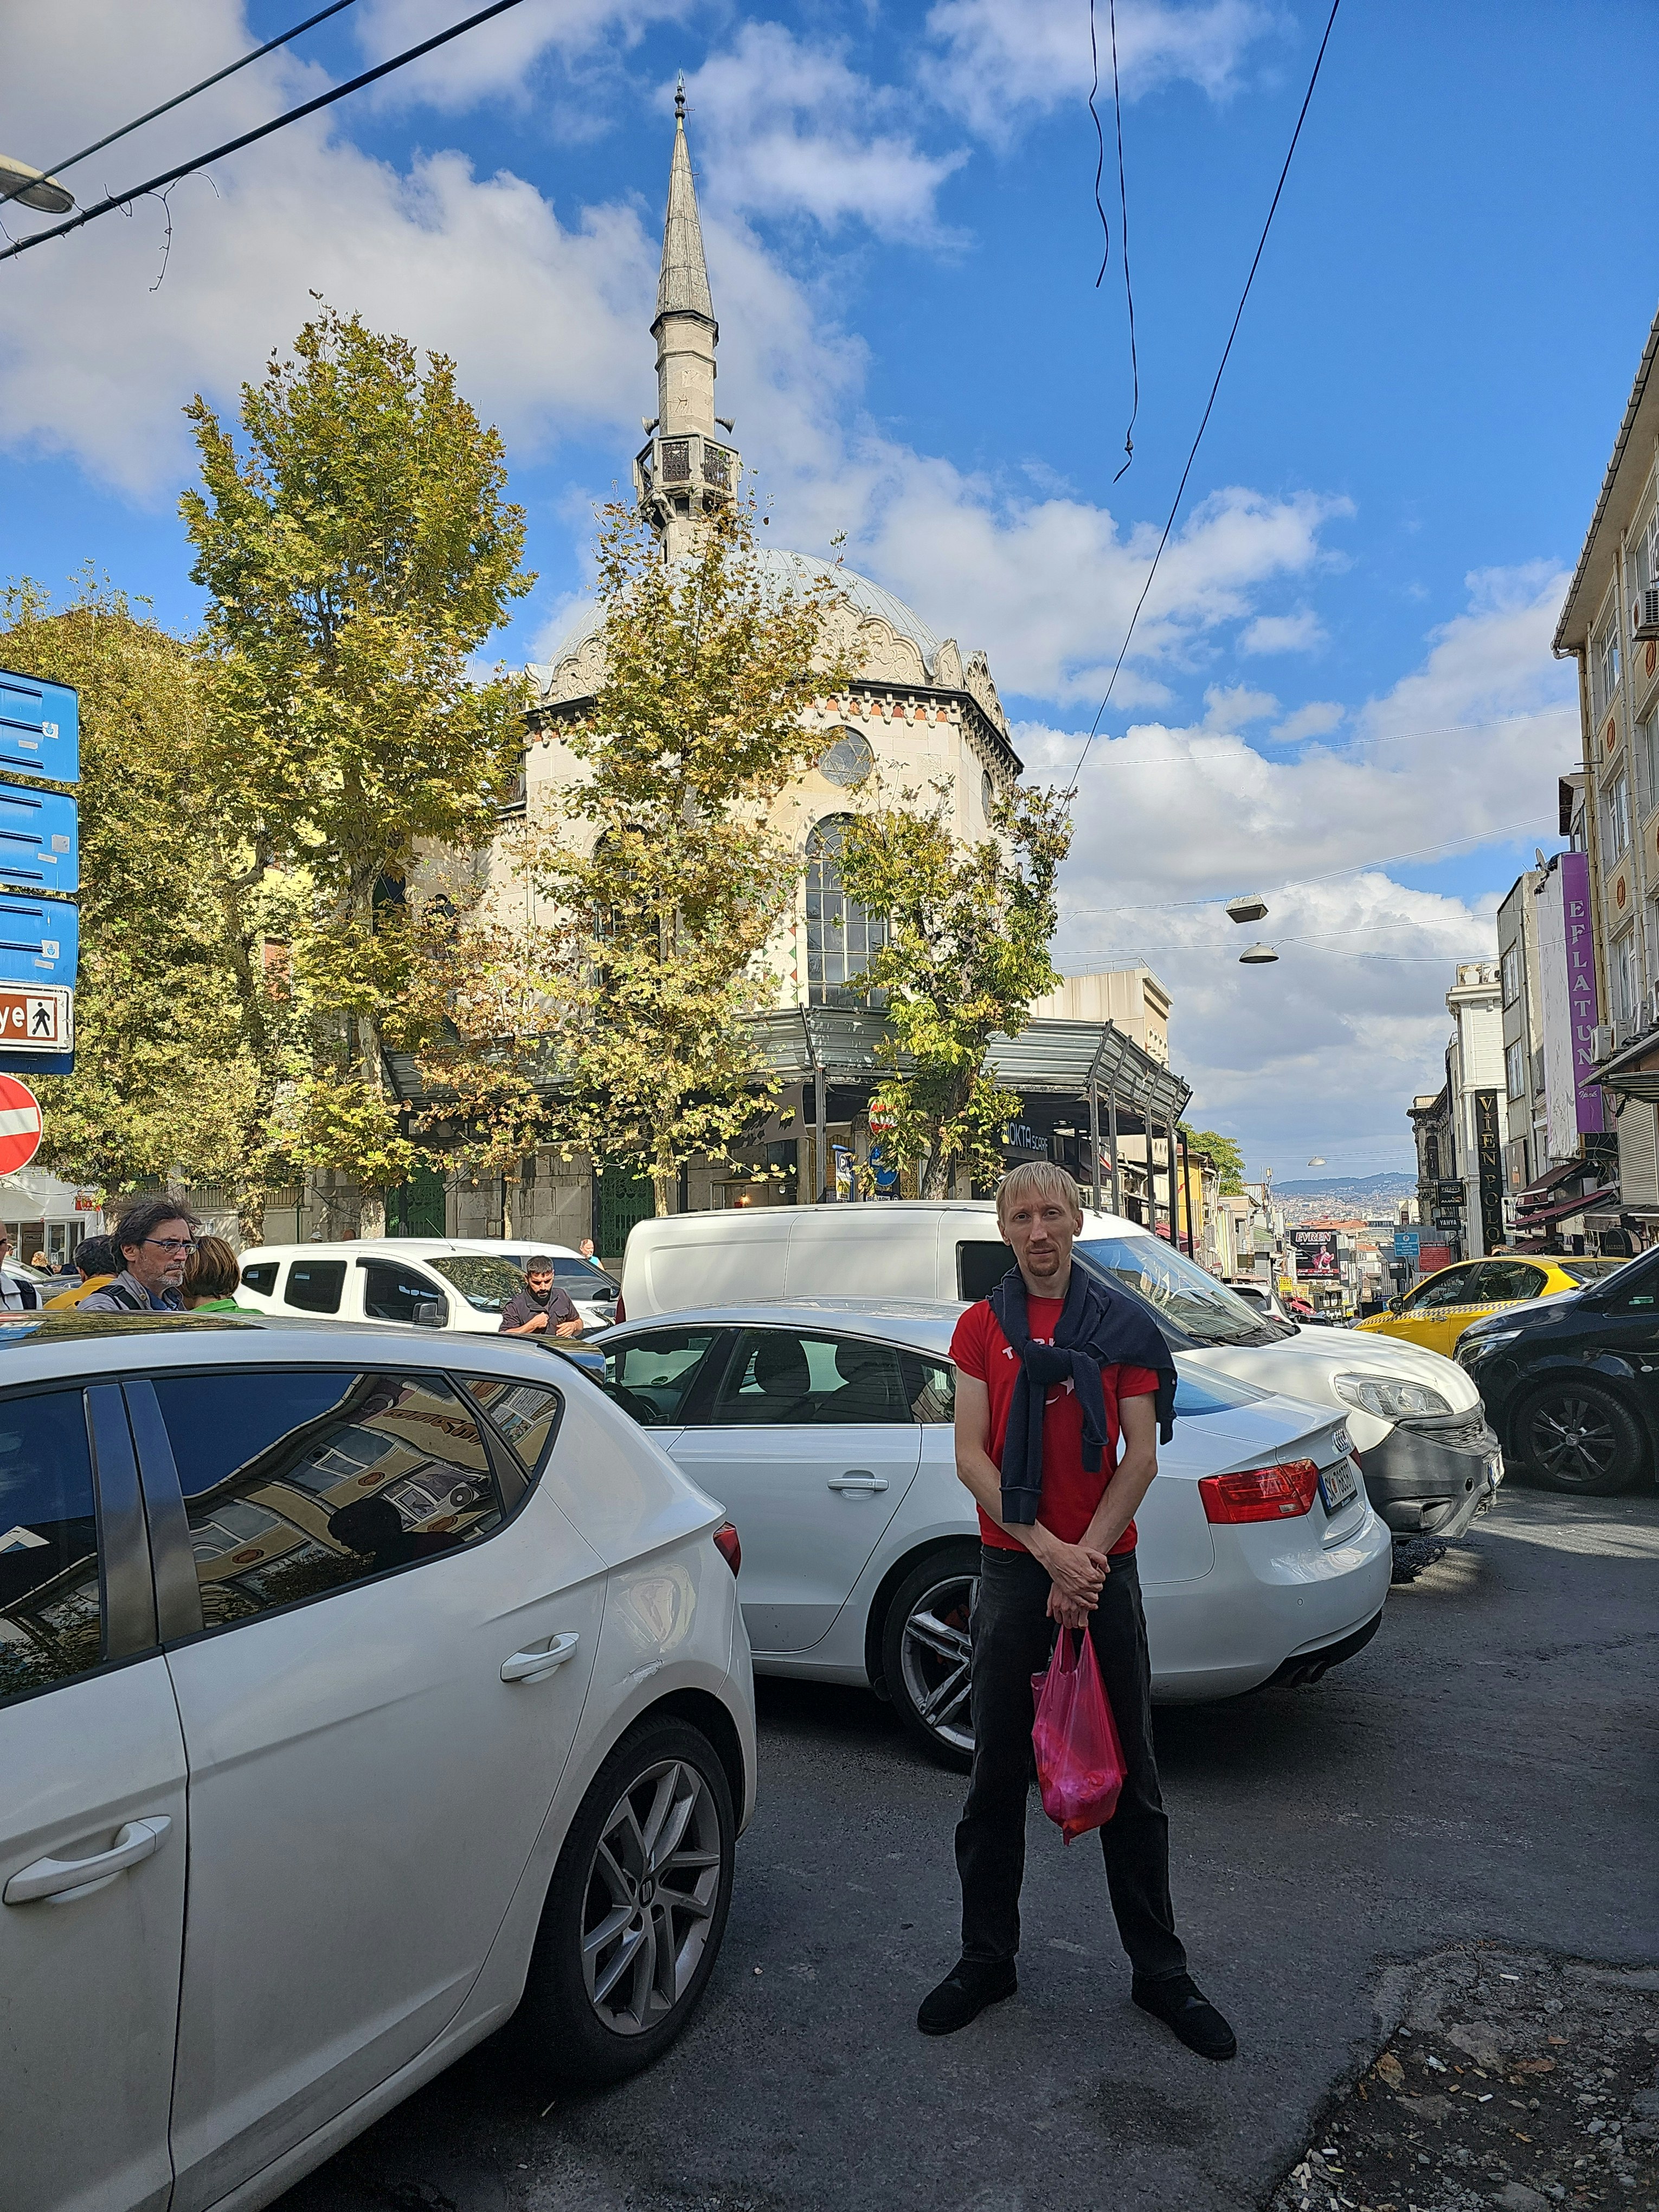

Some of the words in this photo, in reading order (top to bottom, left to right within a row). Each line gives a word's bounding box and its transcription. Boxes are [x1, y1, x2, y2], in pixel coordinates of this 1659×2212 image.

[1569, 900, 1592, 1066] EFLATUN
[1295, 1231, 1332, 1242] EVREN
[1483, 1175, 1501, 1242] POLO
